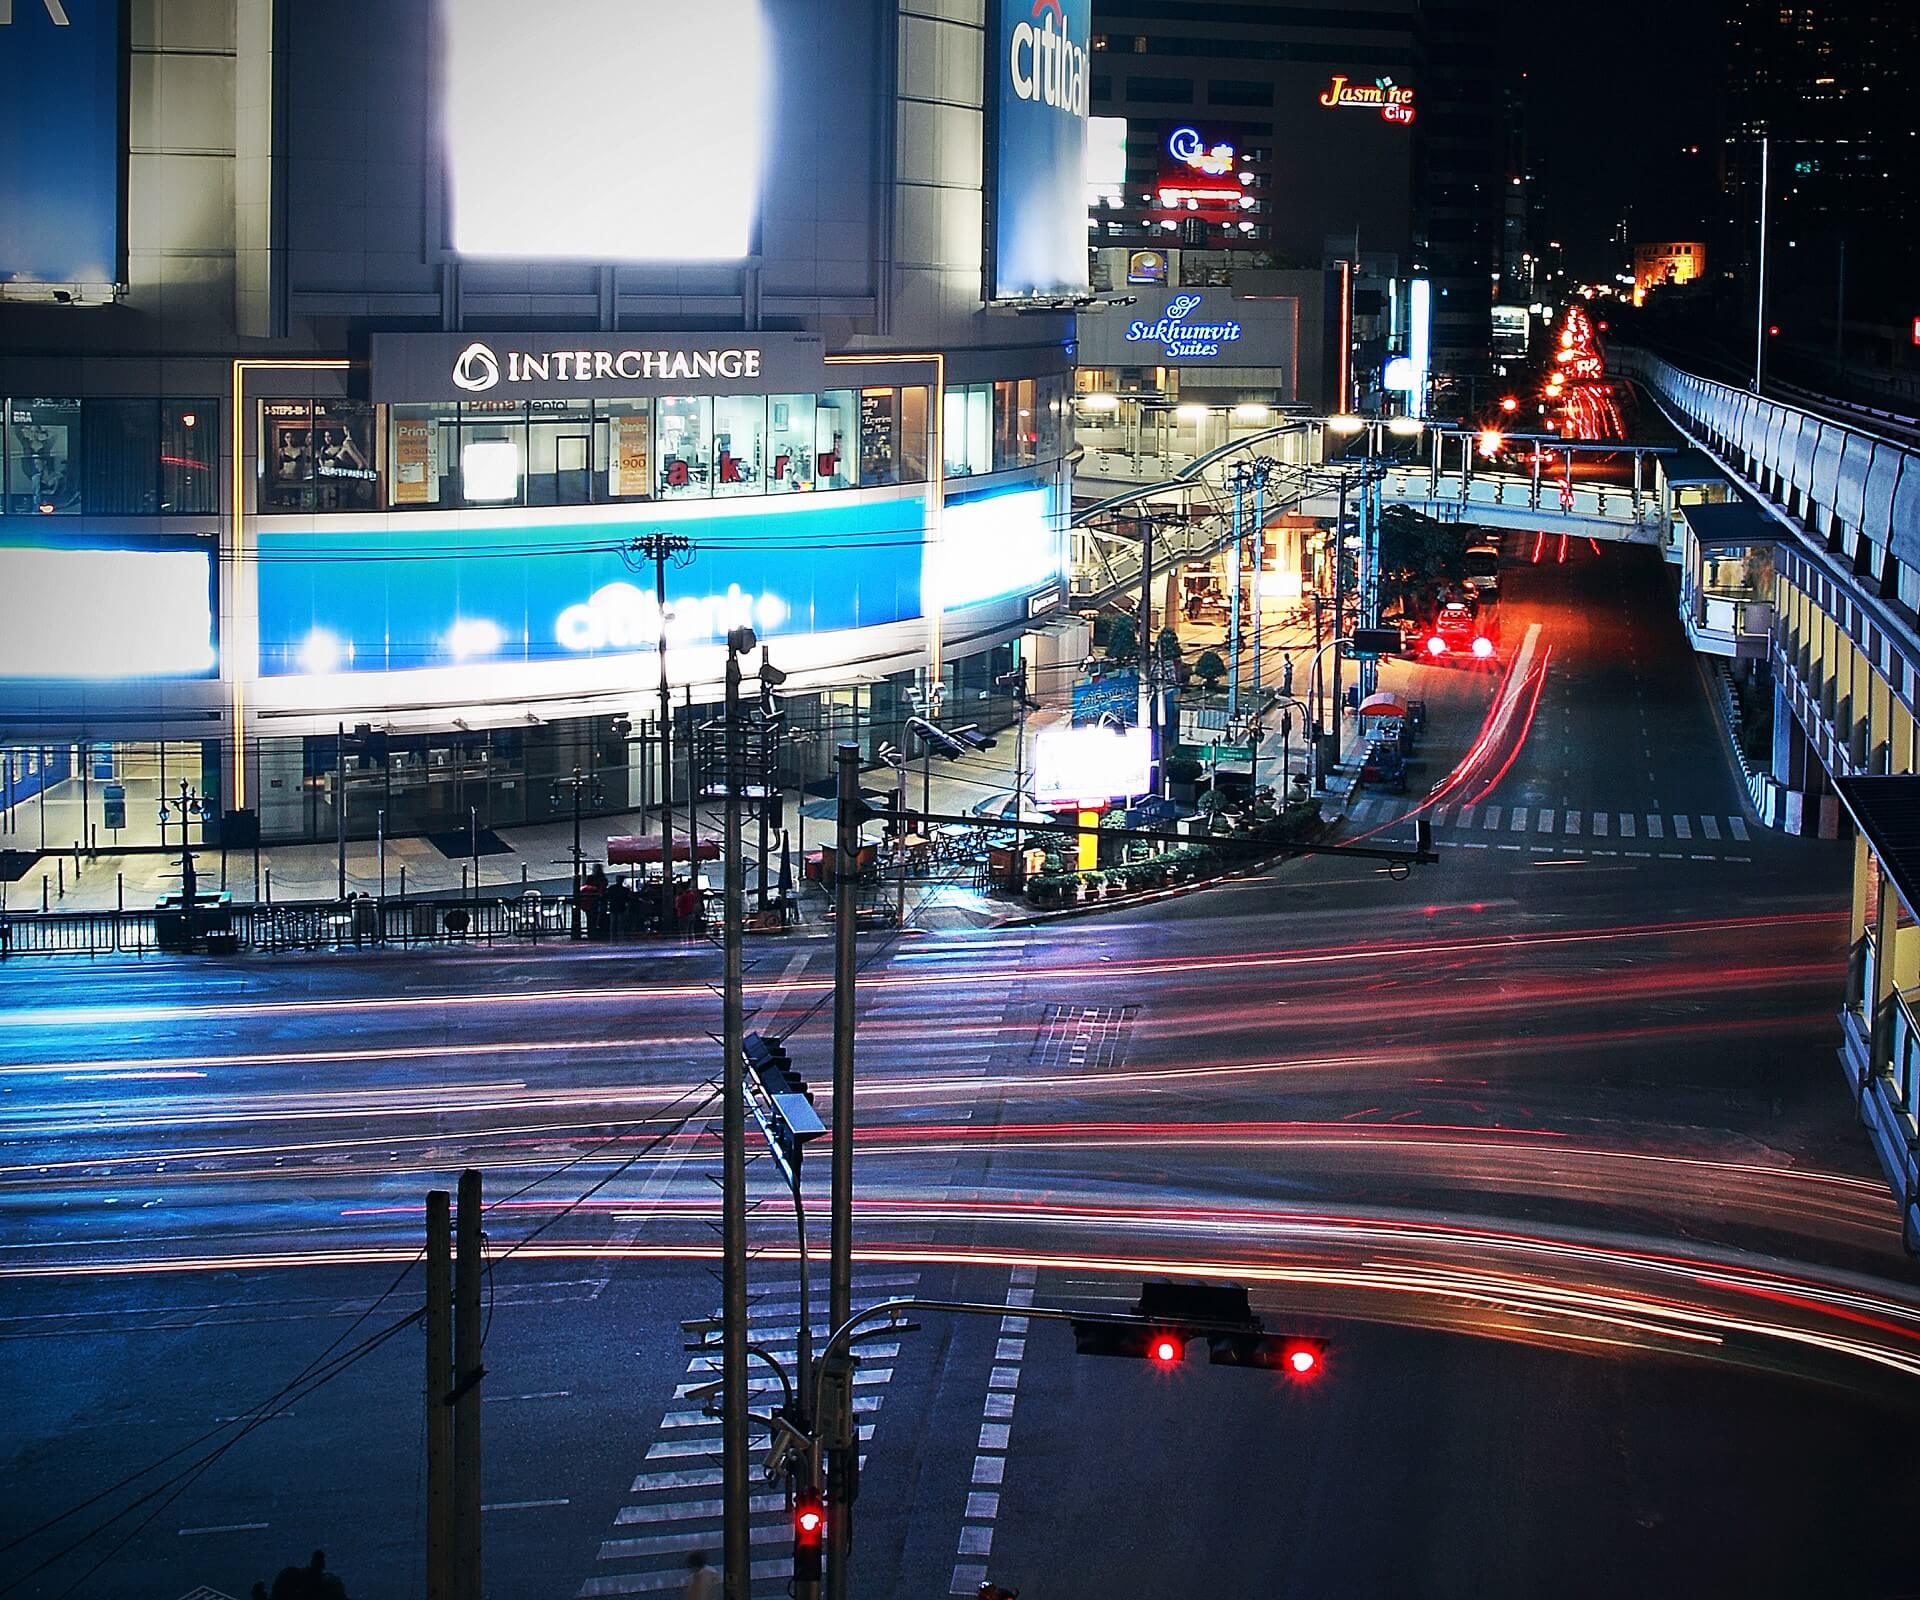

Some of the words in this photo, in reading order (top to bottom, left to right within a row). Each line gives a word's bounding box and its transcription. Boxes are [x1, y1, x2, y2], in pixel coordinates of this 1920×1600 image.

[1384, 106, 1413, 123] City
[1125, 319, 1240, 343] Sukhumvit
[1166, 340, 1219, 357] Suites
[507, 350, 761, 382] INTERCHANGE
